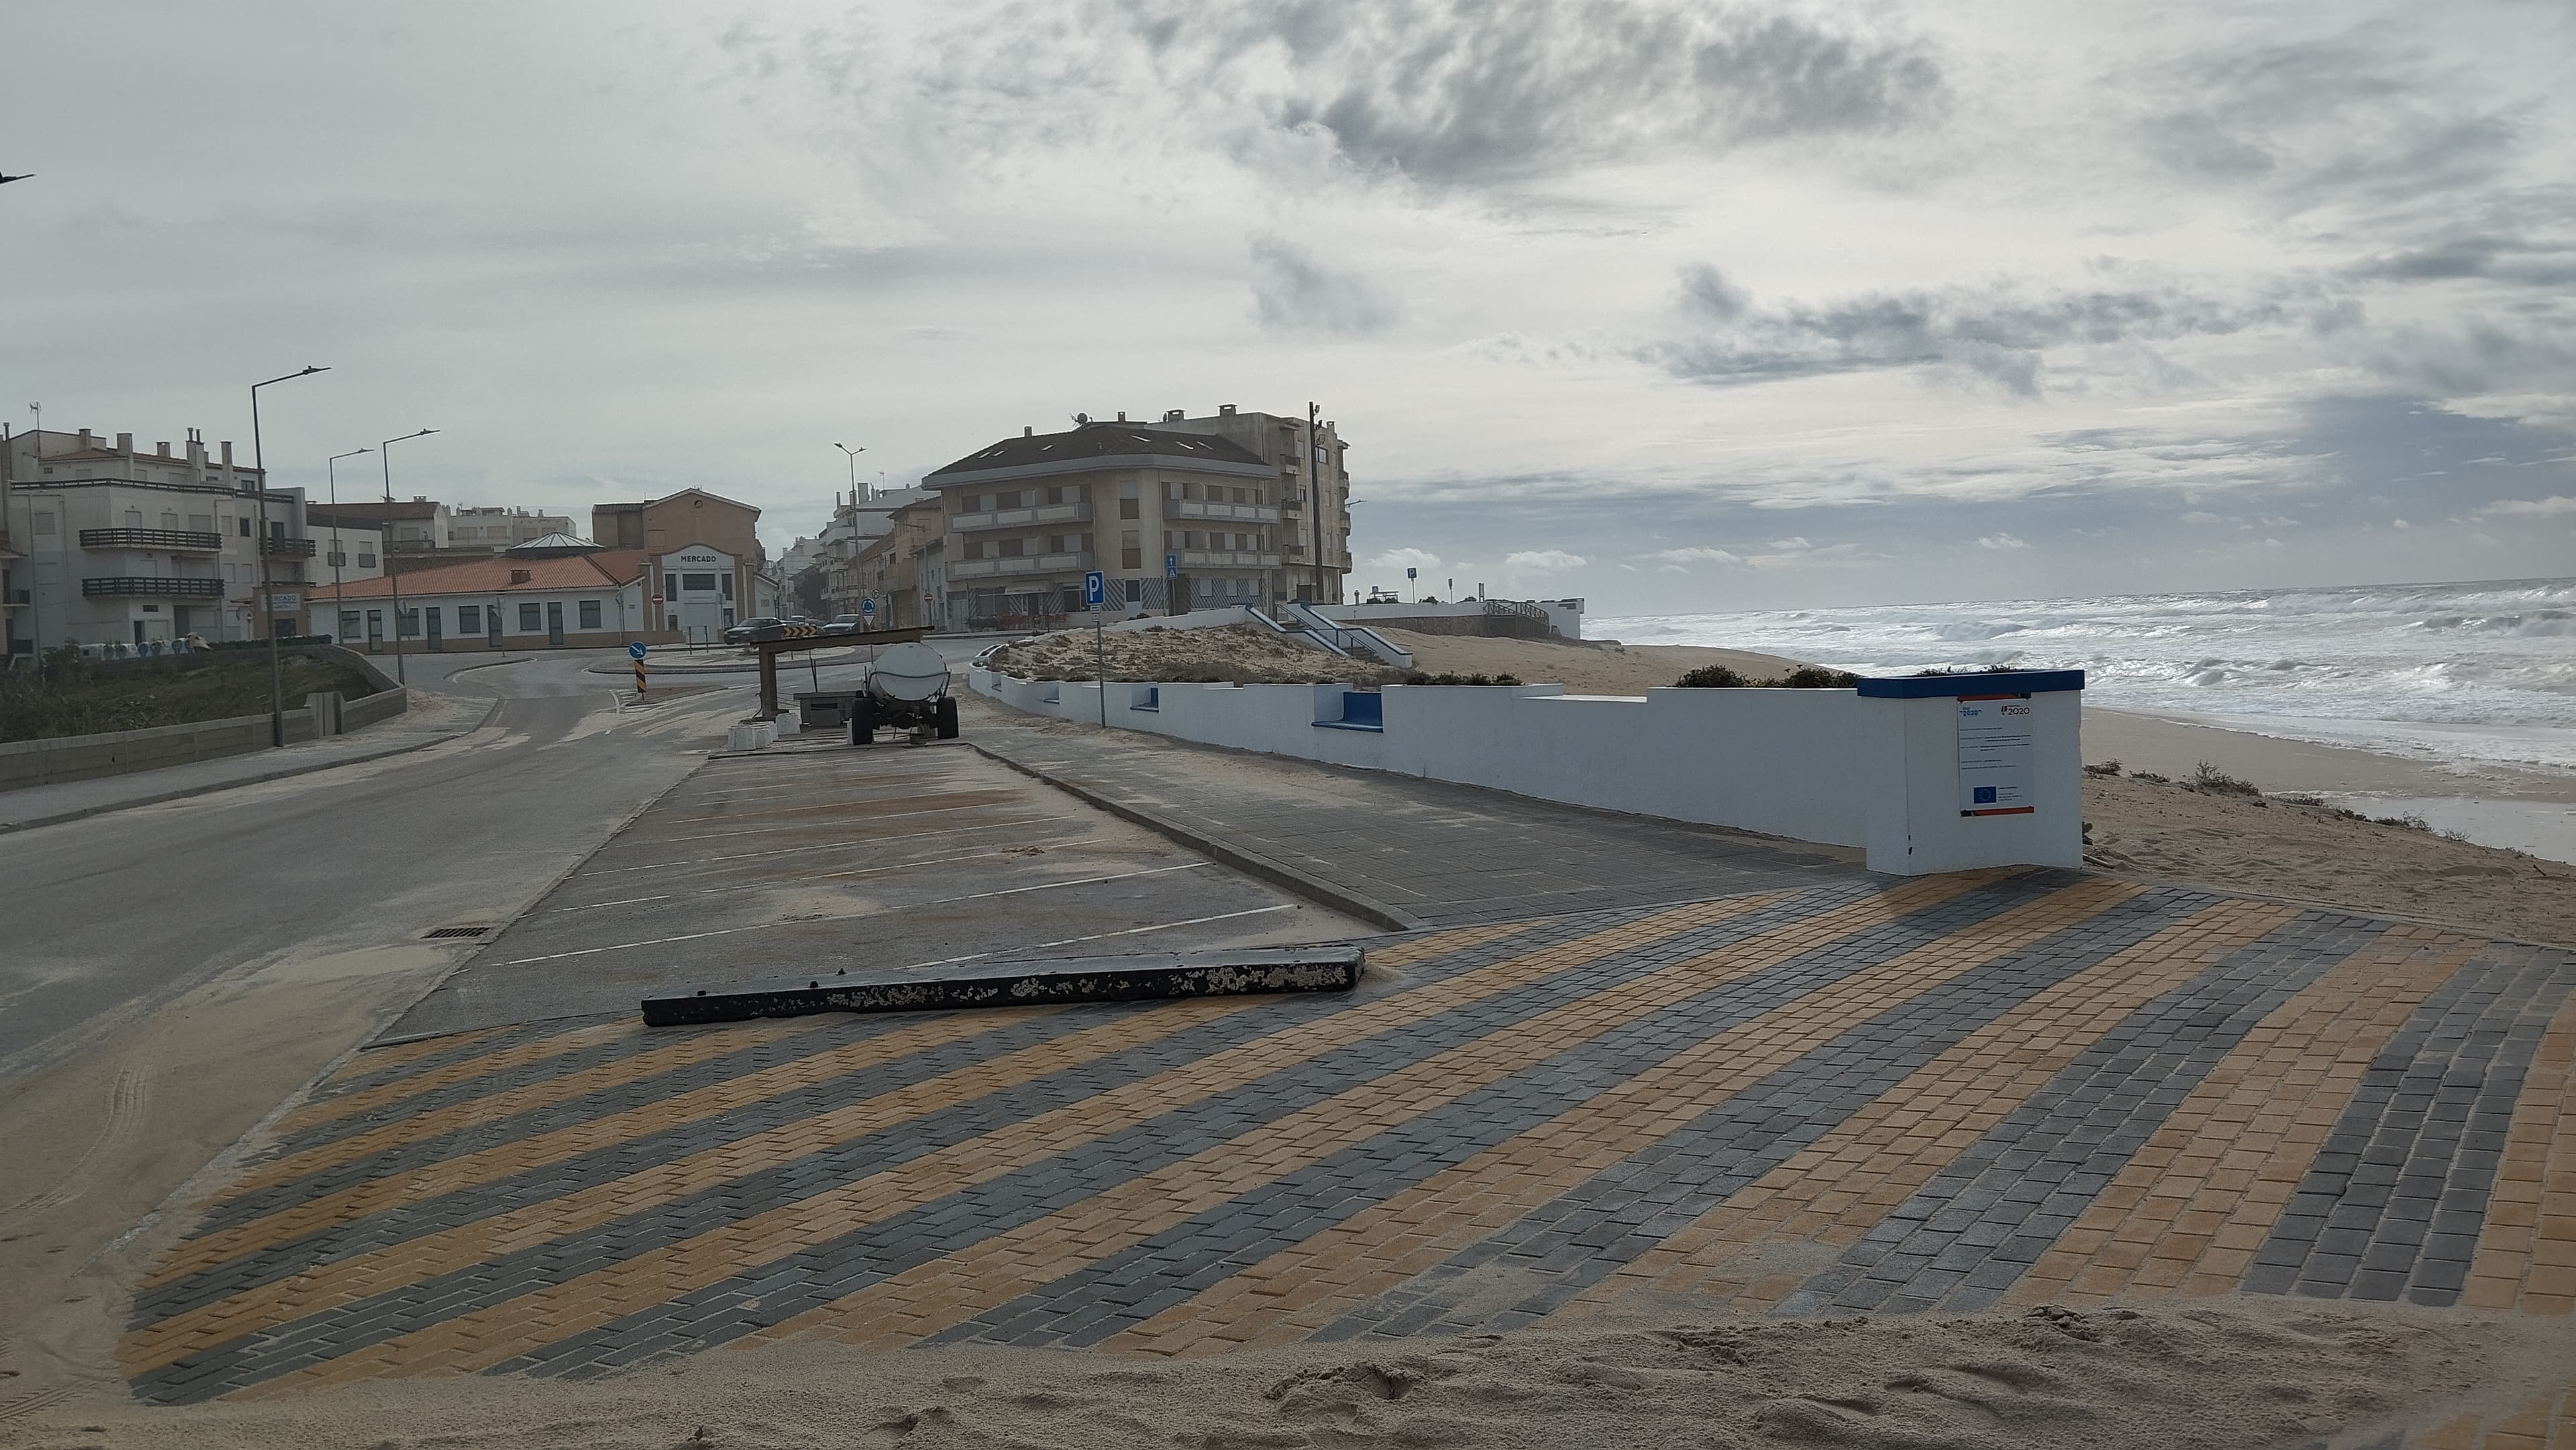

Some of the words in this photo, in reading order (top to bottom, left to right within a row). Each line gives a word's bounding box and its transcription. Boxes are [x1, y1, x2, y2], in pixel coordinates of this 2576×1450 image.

[1409, 569, 1415, 578] P
[1089, 576, 1099, 601] P
[2008, 707, 2030, 715] 2020
